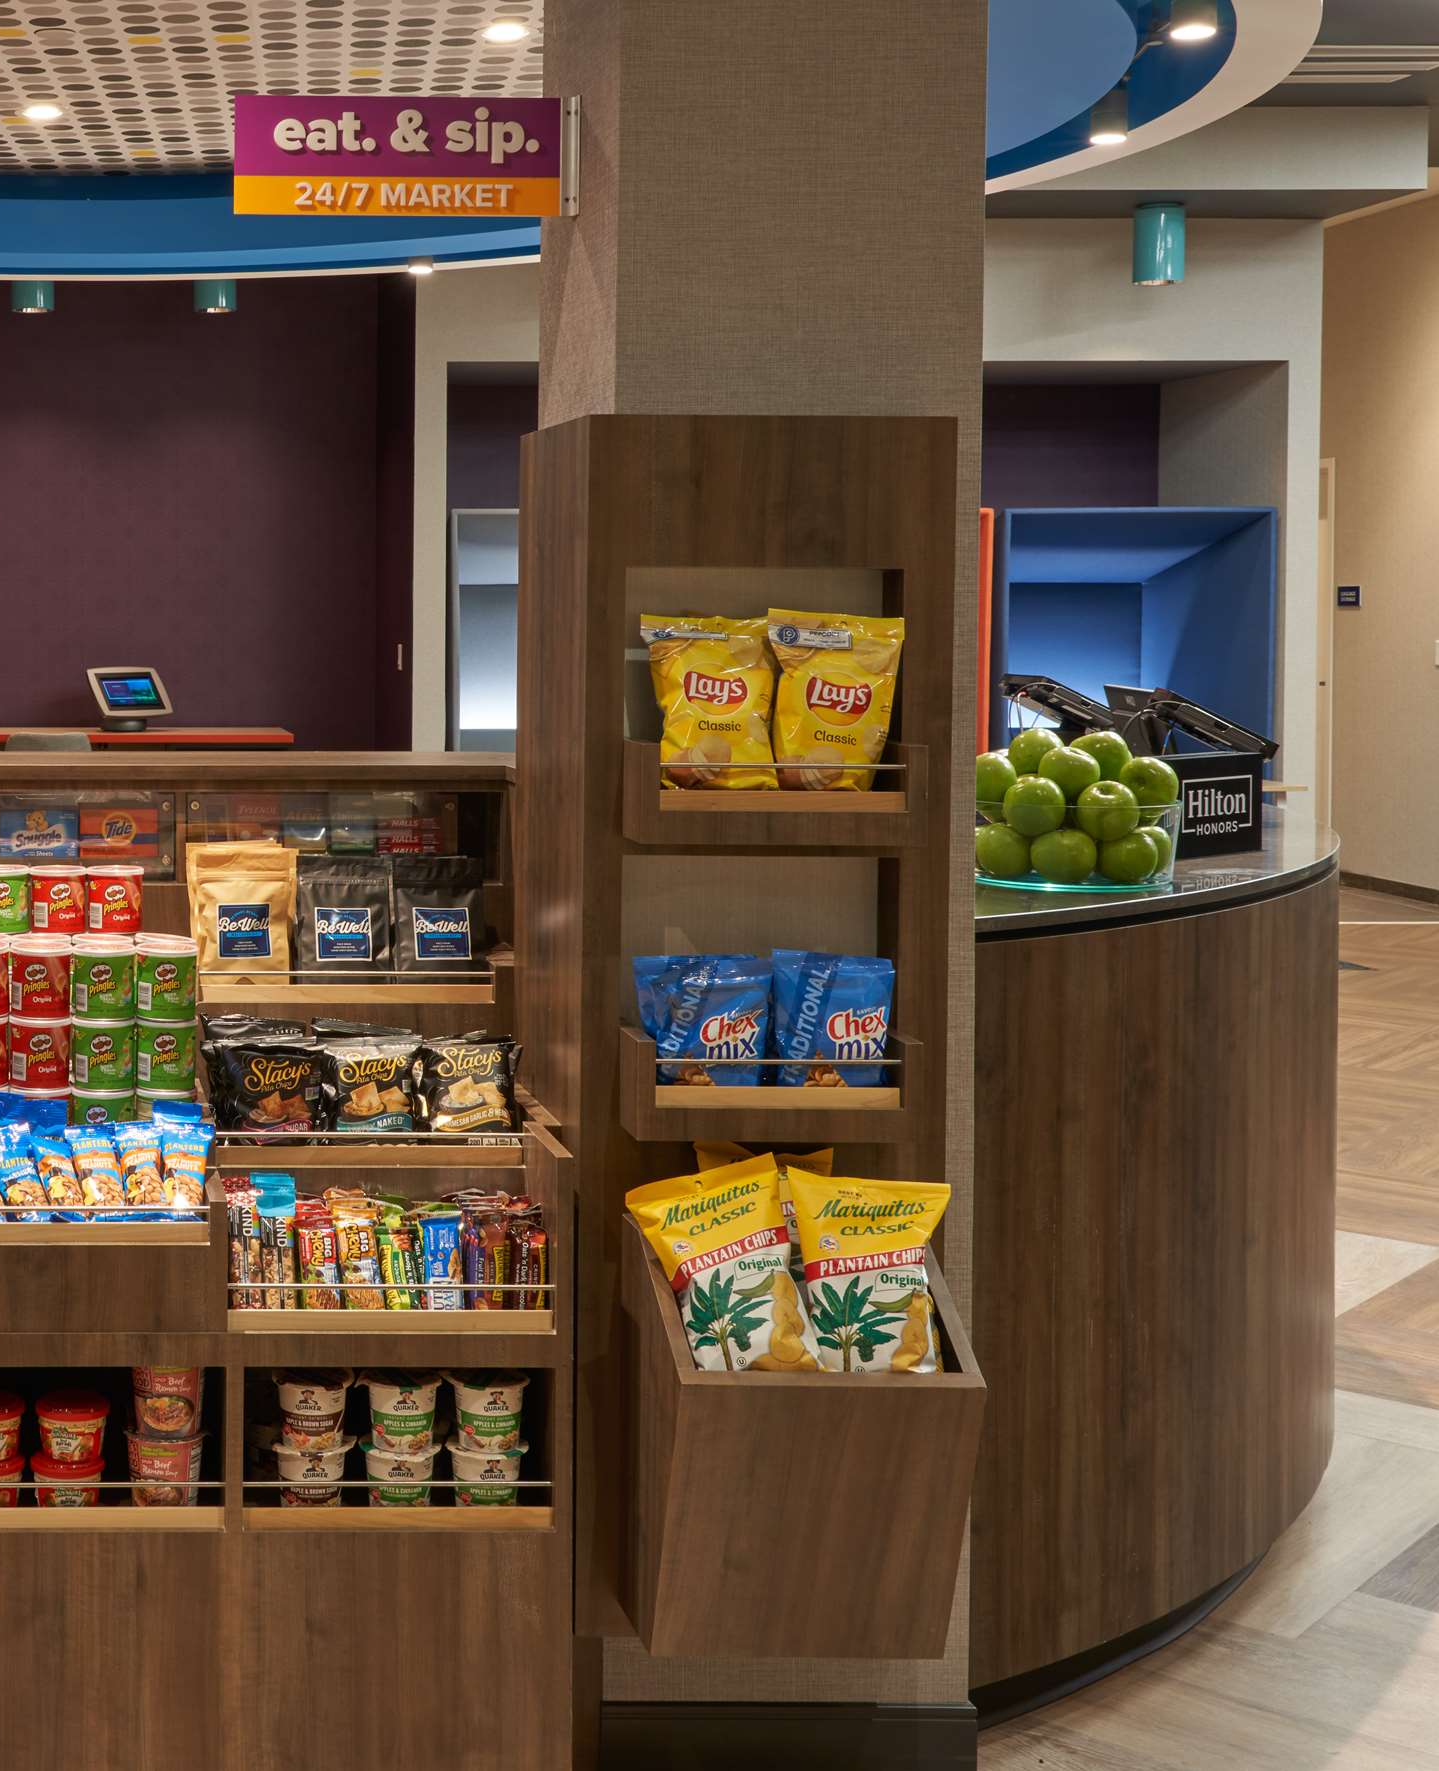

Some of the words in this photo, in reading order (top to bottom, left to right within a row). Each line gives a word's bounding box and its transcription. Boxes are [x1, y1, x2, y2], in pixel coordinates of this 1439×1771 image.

[273, 111, 377, 152] eat.
[390, 108, 431, 153] &
[444, 106, 541, 165] sip.
[293, 181, 370, 207] 24/7
[380, 182, 514, 208] MARKET
[689, 671, 744, 705] Lay's
[811, 676, 869, 712] Lay's
[698, 720, 742, 732] Classic
[814, 730, 857, 746] Classic
[1187, 788, 1246, 819] Hilton
[105, 820, 133, 839] Tide
[392, 818, 419, 828] HALLS
[1196, 820, 1239, 836] HONORS
[15, 831, 62, 849] Snuggle
[392, 834, 419, 844] HALLS
[49, 897, 74, 914] Pringles
[103, 898, 129, 915] Pringles
[218, 916, 270, 932] BeWell
[317, 919, 371, 934] BeWell
[416, 919, 469, 934] BeWell
[24, 979, 50, 996] Pringles
[89, 979, 116, 998] Pringles
[153, 979, 181, 997] Pringles
[700, 1014, 758, 1043] Chex
[828, 1008, 888, 1040] Chex
[709, 1032, 756, 1060] mix
[838, 1033, 887, 1060] mix
[339, 1052, 407, 1085] Stacy's
[437, 1047, 502, 1077] Stacy's
[244, 1058, 311, 1093] Stacy's
[371, 1071, 389, 1082] Chips
[275, 1080, 293, 1091] Chips
[376, 1117, 403, 1129] NAKED
[164, 1143, 204, 1153] PLANTERS
[661, 1180, 761, 1231] Mariquitas
[814, 1199, 926, 1221] Mariquitas
[241, 1206, 253, 1237] KIND
[688, 1201, 757, 1237] CLASSIC
[275, 1216, 288, 1247] KIND
[840, 1220, 913, 1237] CLASSIC
[323, 1236, 333, 1258] BIG
[359, 1231, 369, 1253] BIG
[680, 1240, 744, 1276] PLANTAIN
[746, 1228, 778, 1252] CHIPS
[738, 1256, 783, 1274] Original
[819, 1253, 888, 1277] PLANTAIN
[880, 1273, 925, 1291] Original
[168, 1376, 186, 1386] Beef
[295, 1403, 322, 1411] QUAKER
[393, 1404, 419, 1413] QUAKER
[483, 1404, 510, 1413] QUAKER
[154, 1459, 171, 1469] Beef
[302, 1471, 329, 1480] QUAKER
[388, 1470, 415, 1480] QUAKER
[480, 1471, 506, 1481] QUAKER
